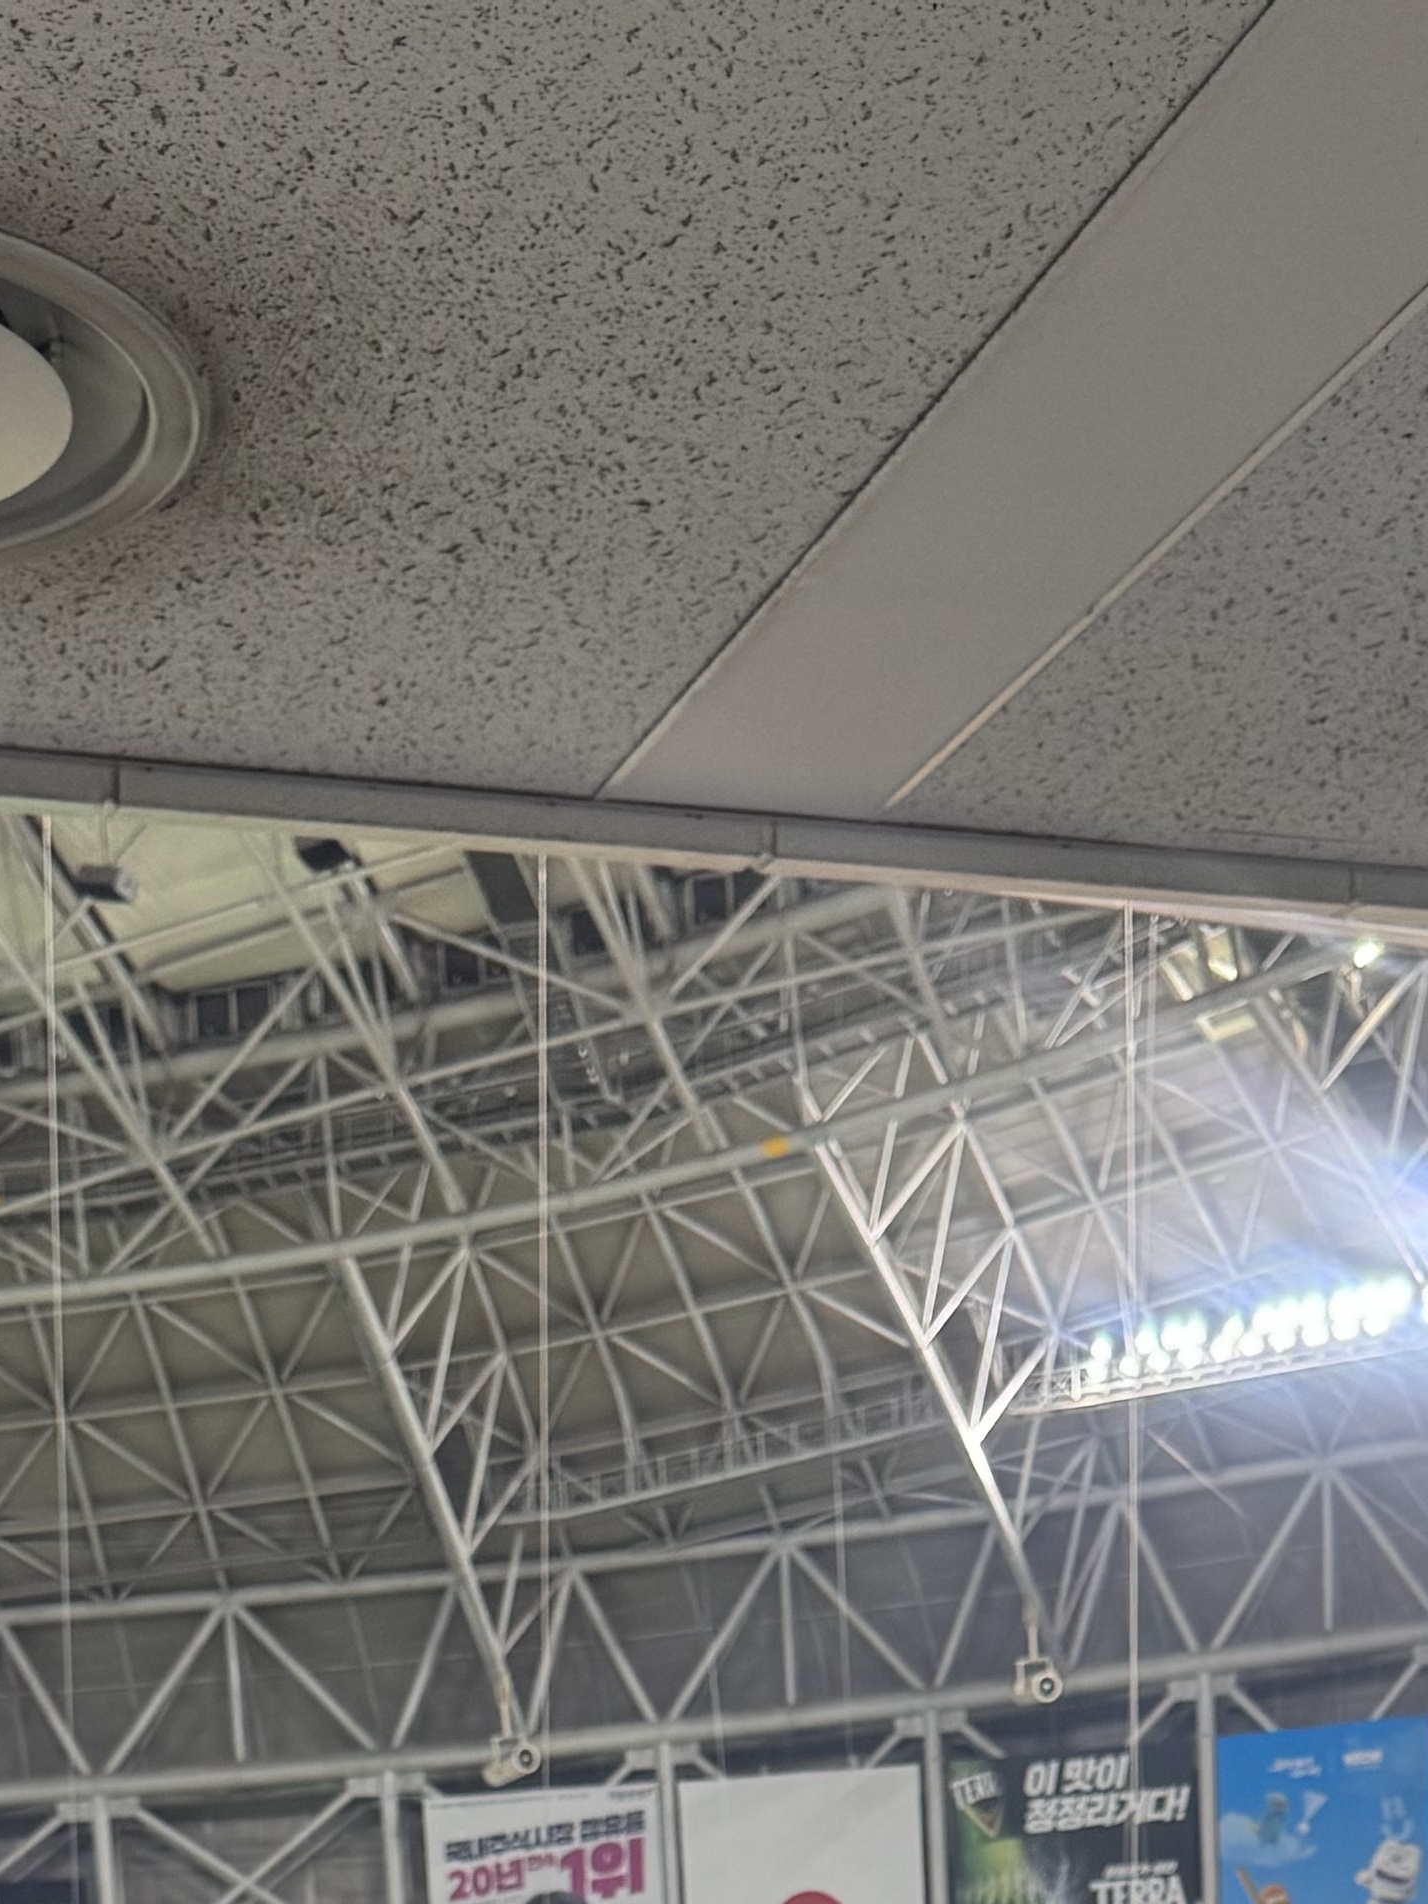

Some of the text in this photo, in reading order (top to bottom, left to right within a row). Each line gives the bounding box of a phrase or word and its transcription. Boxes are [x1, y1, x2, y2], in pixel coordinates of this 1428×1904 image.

[1024, 1755, 1130, 1796] 이 맛이
[1023, 1786, 1190, 1834] 청정라거다!
[448, 1855, 527, 1903] 20년
[561, 1837, 646, 1903] 1위
